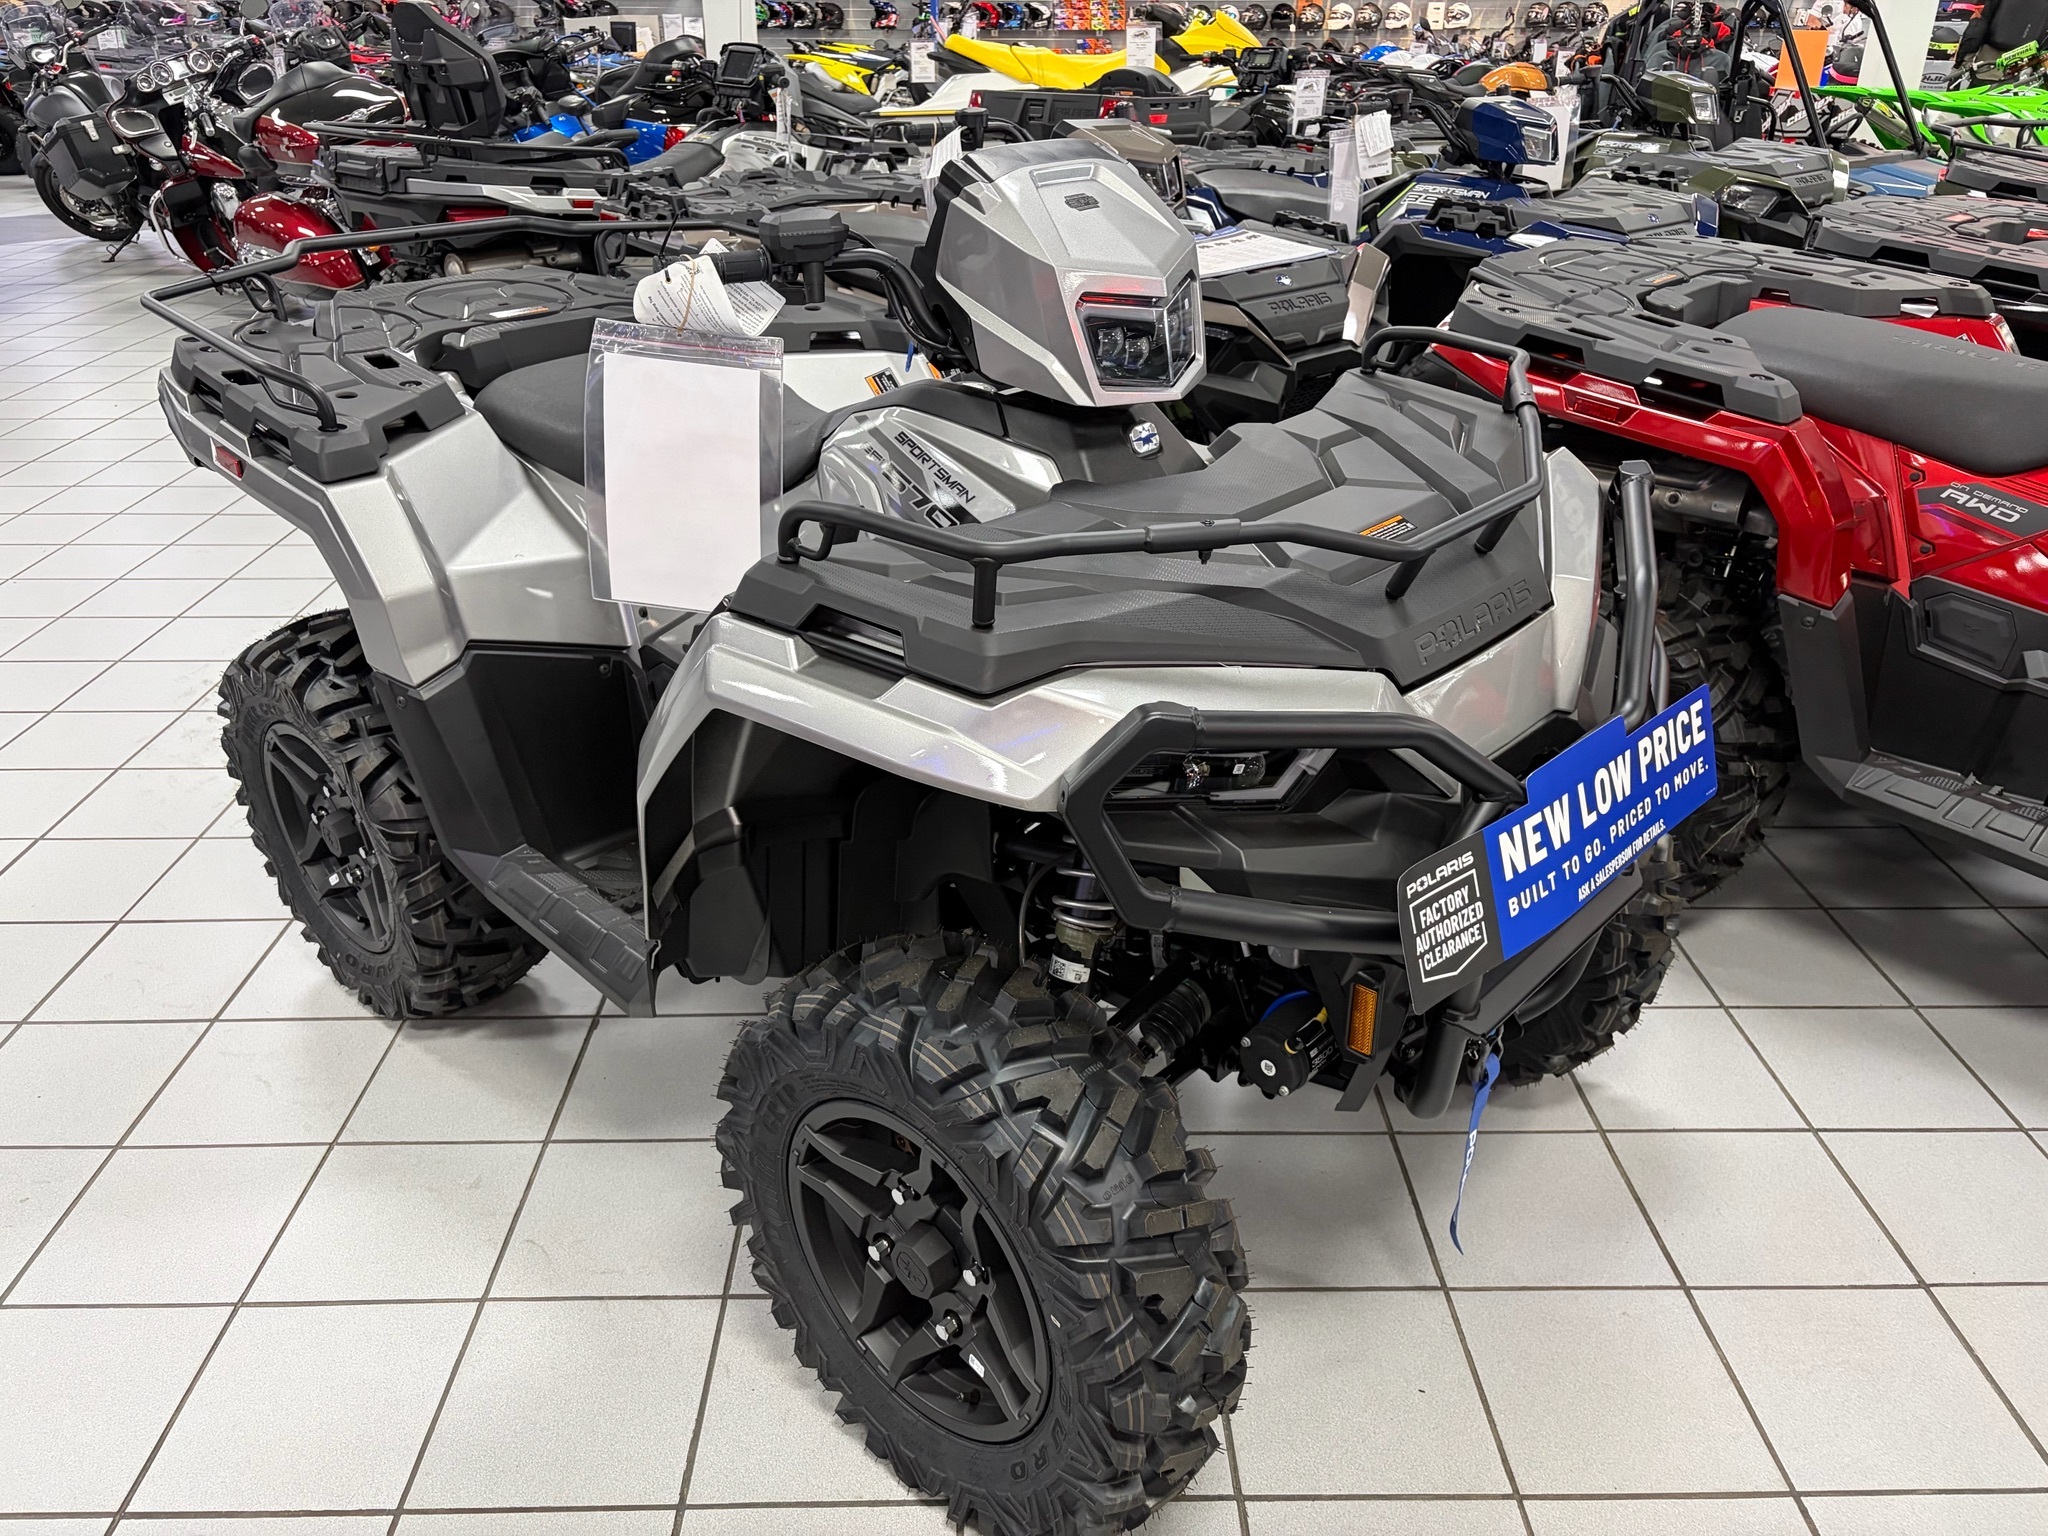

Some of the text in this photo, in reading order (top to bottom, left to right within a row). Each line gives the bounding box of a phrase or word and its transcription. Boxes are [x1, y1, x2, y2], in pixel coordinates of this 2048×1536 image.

[1412, 184, 1491, 200] SPORTSMAN
[1267, 292, 1333, 314] POLARIS
[894, 430, 976, 504] SPORTSMAN
[881, 461, 959, 528] 570
[1939, 488, 2022, 524] AWD
[1949, 482, 2029, 514] ON DEMAND
[1413, 578, 1533, 666] POLARIS
[1498, 698, 1706, 882] NEW LOW PRICE
[1507, 756, 1709, 918] BUILT TO GO. PRICED TO MOVE.
[1578, 881, 1591, 902] ASK
[1595, 845, 1633, 887] SALESPERSON
[1632, 835, 1644, 855] FOR
[1642, 818, 1667, 846] DETAILS.
[1406, 851, 1474, 899] POLARIS
[1415, 901, 1484, 956] AUTHORIZED
[1419, 884, 1470, 929] FACTORY
[1424, 926, 1482, 971] CLEARANCE
[1102, 1174, 1135, 1202] DURO
